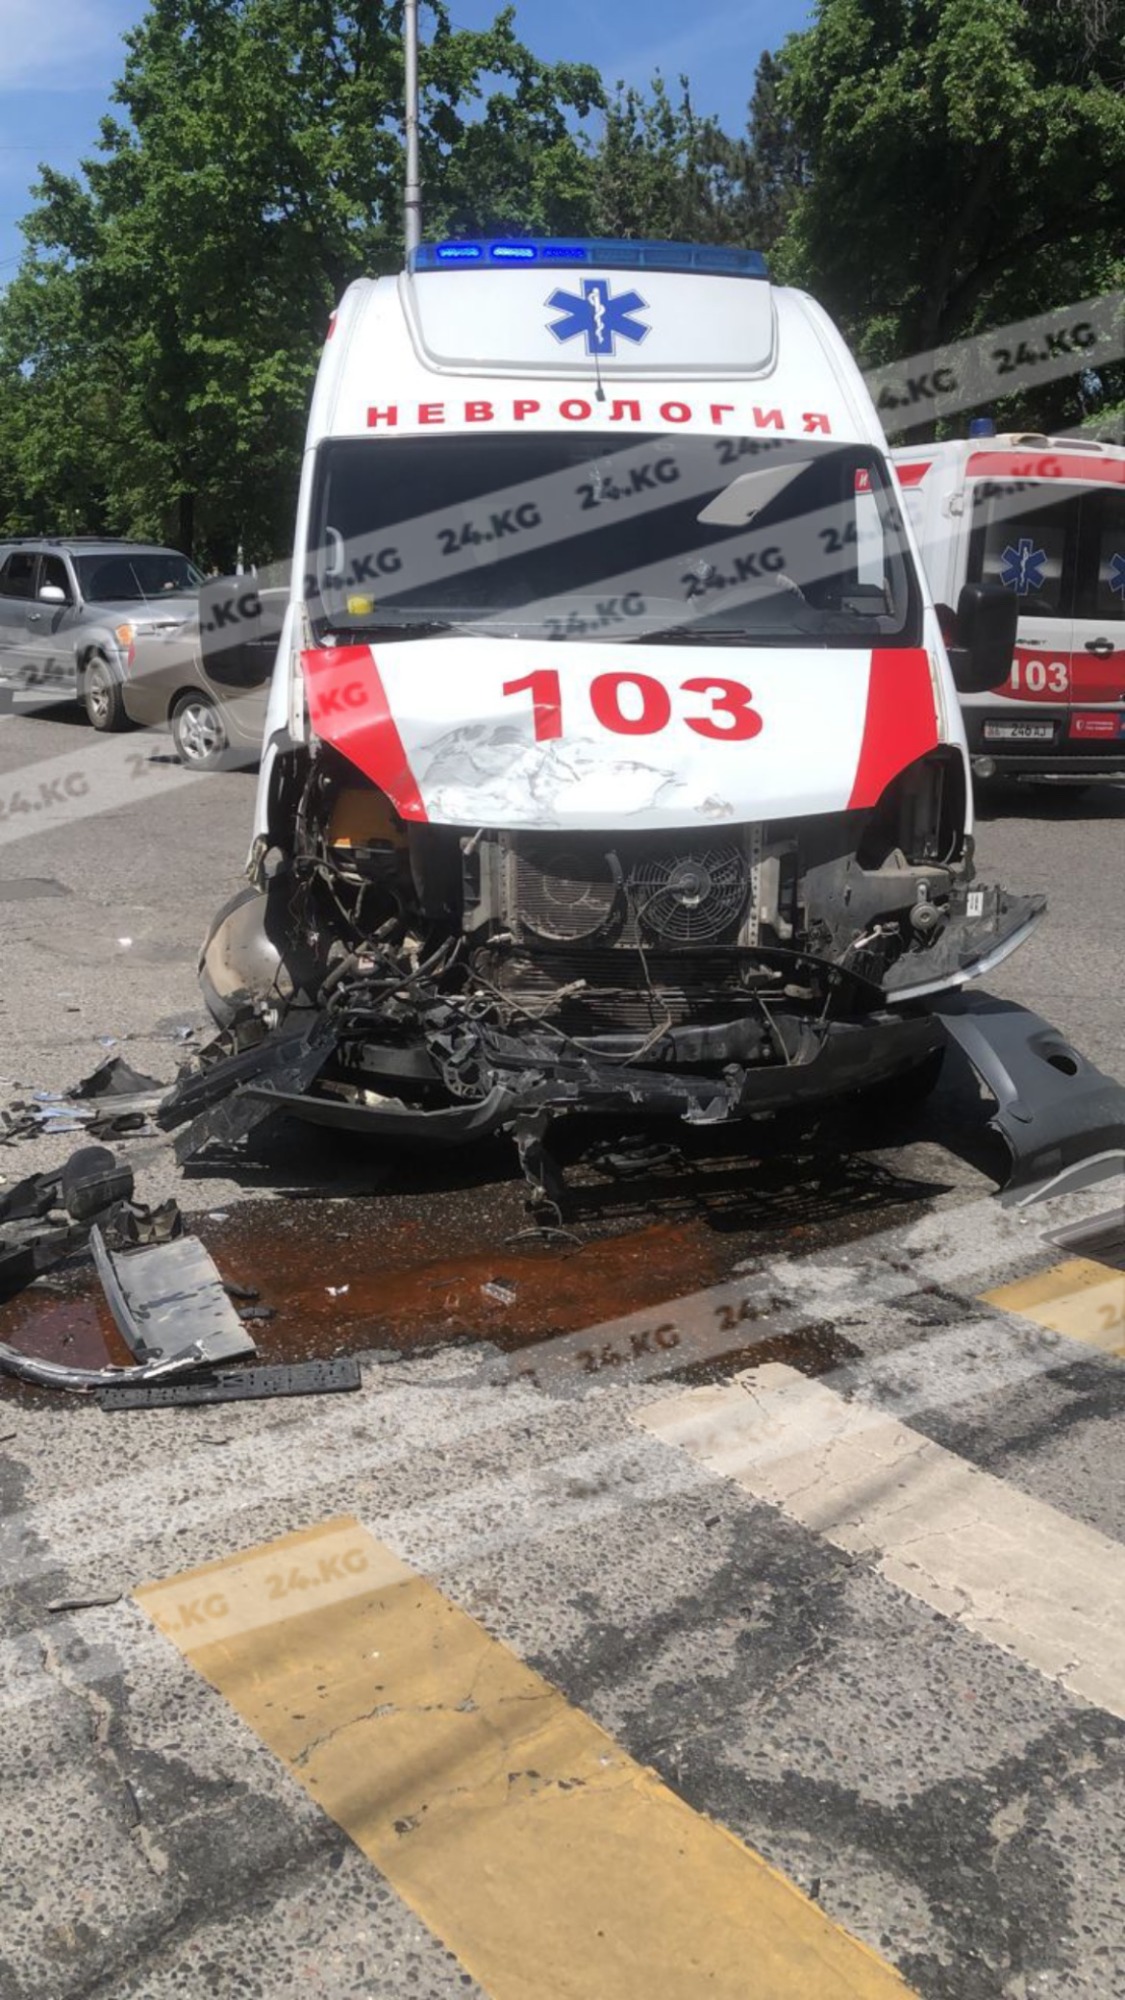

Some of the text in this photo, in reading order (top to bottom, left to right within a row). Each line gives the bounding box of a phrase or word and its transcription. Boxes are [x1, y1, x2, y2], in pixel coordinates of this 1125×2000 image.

[367, 399, 832, 434] НЕВРОЛОГИЯ
[1011, 659, 1069, 692] 103
[503, 669, 763, 742] 103
